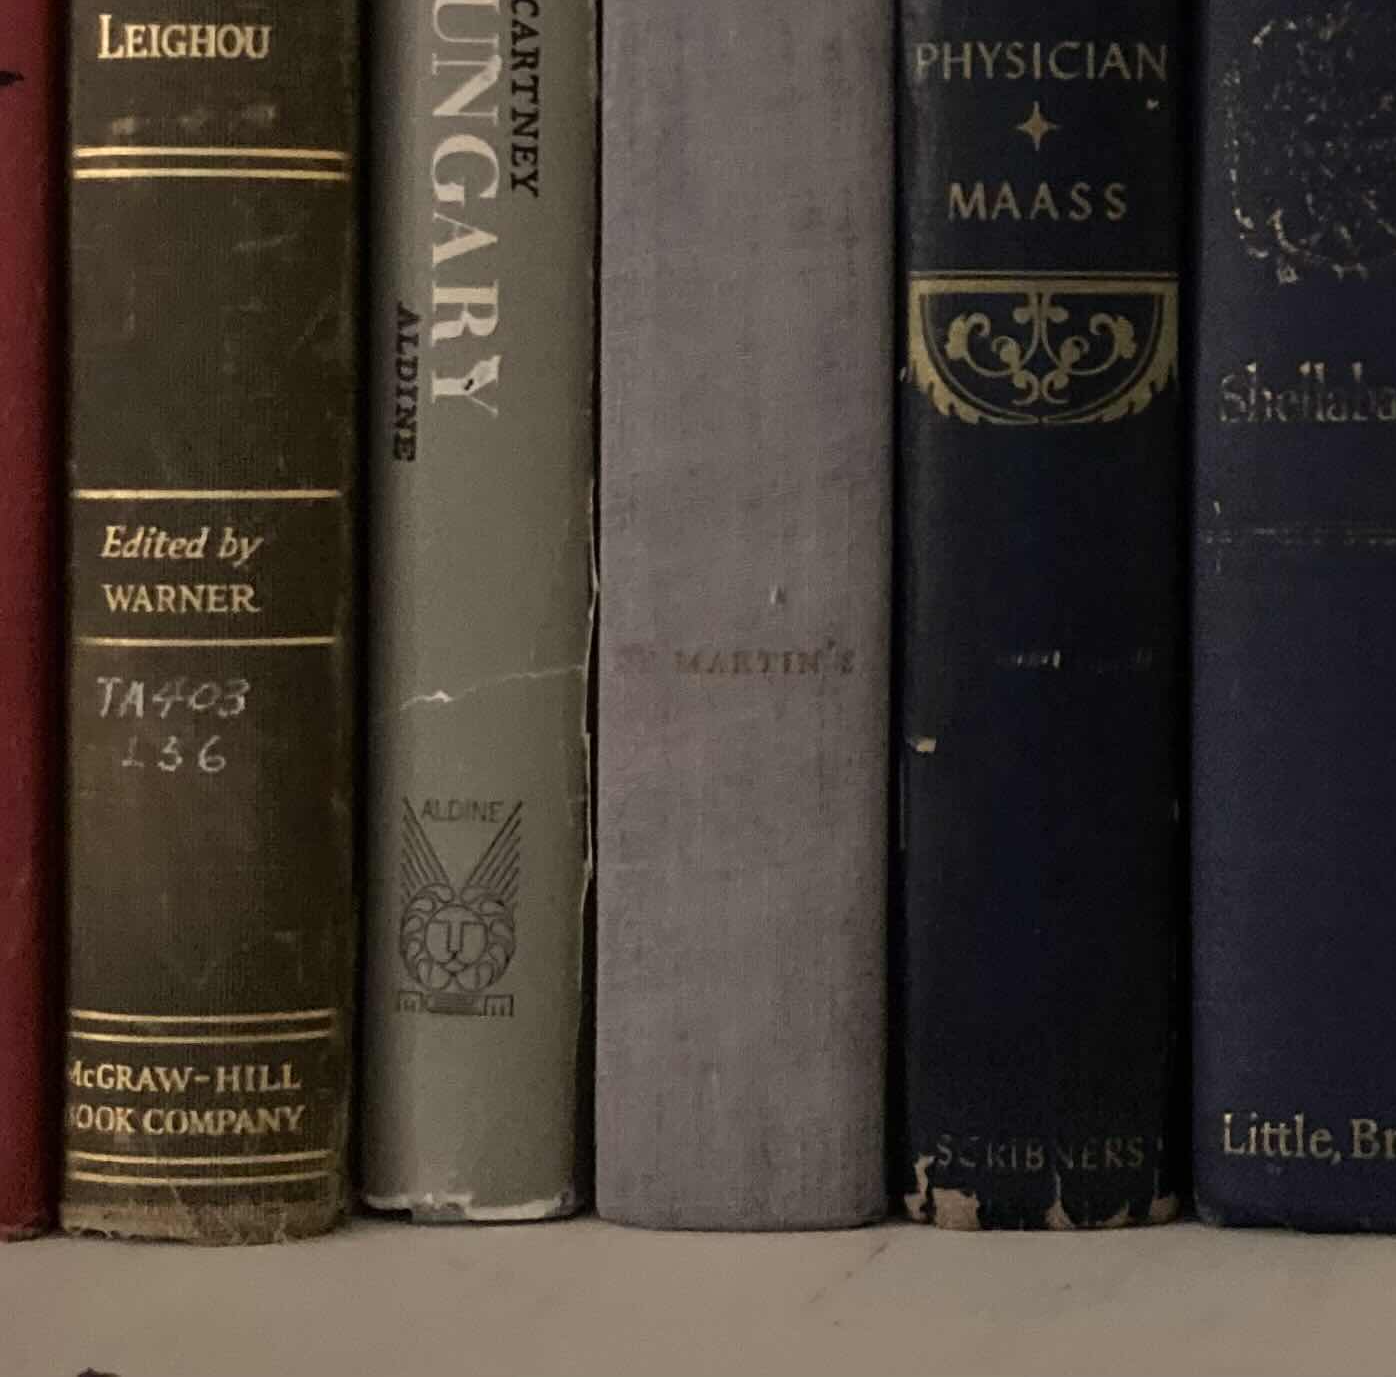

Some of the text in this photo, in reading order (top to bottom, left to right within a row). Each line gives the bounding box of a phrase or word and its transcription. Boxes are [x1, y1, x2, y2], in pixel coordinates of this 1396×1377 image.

[914, 40, 1169, 84] PHYSICIAN
[947, 181, 1129, 222] MAASS
[392, 300, 422, 465] ALDINE
[101, 525, 265, 569] Edited by
[103, 583, 262, 615] WARNER
[420, 798, 505, 824] ALDINE
[141, 1103, 306, 1136] COMPANY
